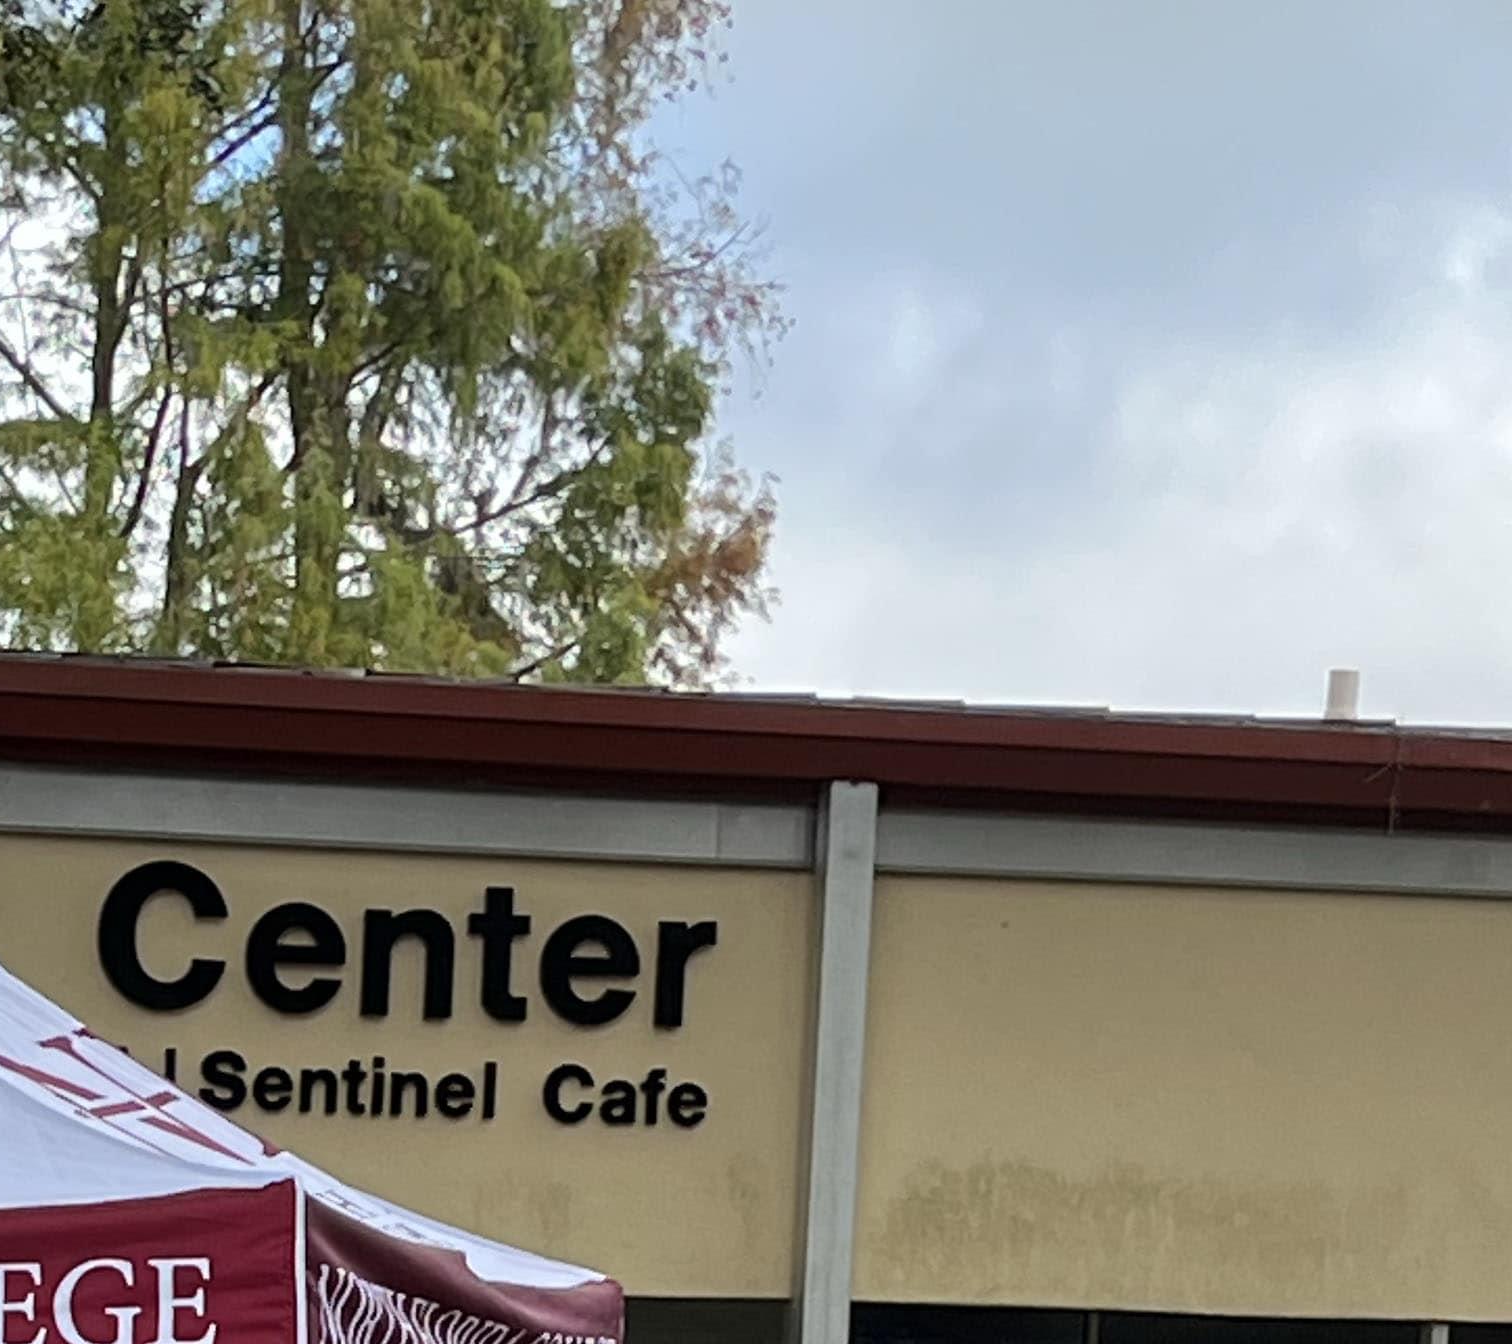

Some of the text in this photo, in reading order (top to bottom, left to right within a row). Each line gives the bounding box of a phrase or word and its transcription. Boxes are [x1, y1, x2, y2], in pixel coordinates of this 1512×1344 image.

[99, 860, 717, 1029] Center
[199, 1050, 496, 1121] Sentinel
[543, 1064, 708, 1127] Cafe
